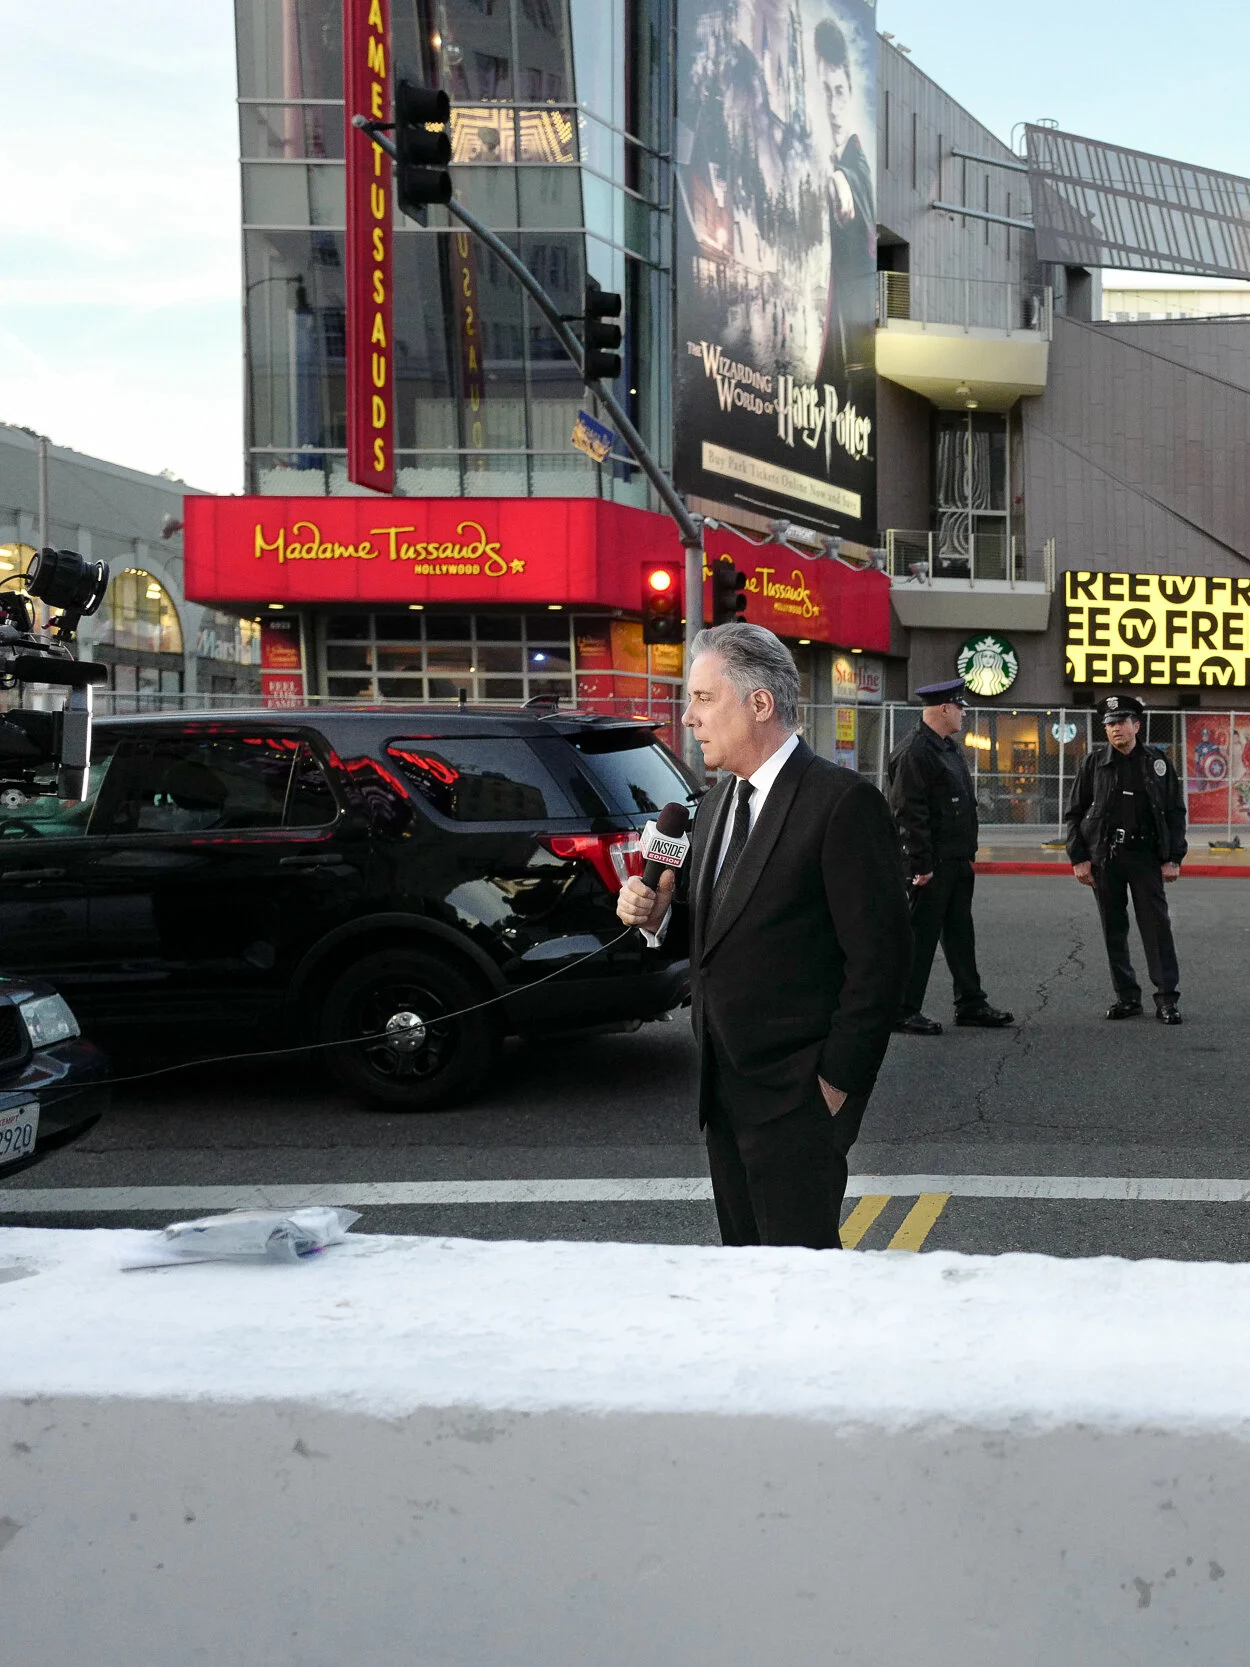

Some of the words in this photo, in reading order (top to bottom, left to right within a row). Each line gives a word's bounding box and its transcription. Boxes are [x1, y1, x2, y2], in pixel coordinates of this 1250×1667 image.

[370, 140, 387, 472] TUSSAUDS
[700, 340, 773, 393] WIZARDING
[716, 375, 764, 415] WORLD
[775, 374, 825, 449] Harry
[823, 383, 872, 479] Potter
[708, 451, 725, 469] Buy
[728, 456, 747, 474] Park
[749, 463, 780, 486] Tickets
[781, 475, 808, 495] Online
[810, 484, 827, 499] Now
[827, 492, 841, 506] and
[254, 521, 379, 564] Madame
[370, 521, 508, 577] Tussauds
[414, 563, 481, 575] HOLLYWOOD
[755, 567, 811, 618] Tussauds
[1165, 609, 1244, 651] FRE
[648, 853, 680, 865] EDITION
[651, 839, 685, 859] INSIDE
[0, 1114, 19, 1126] EMPT
